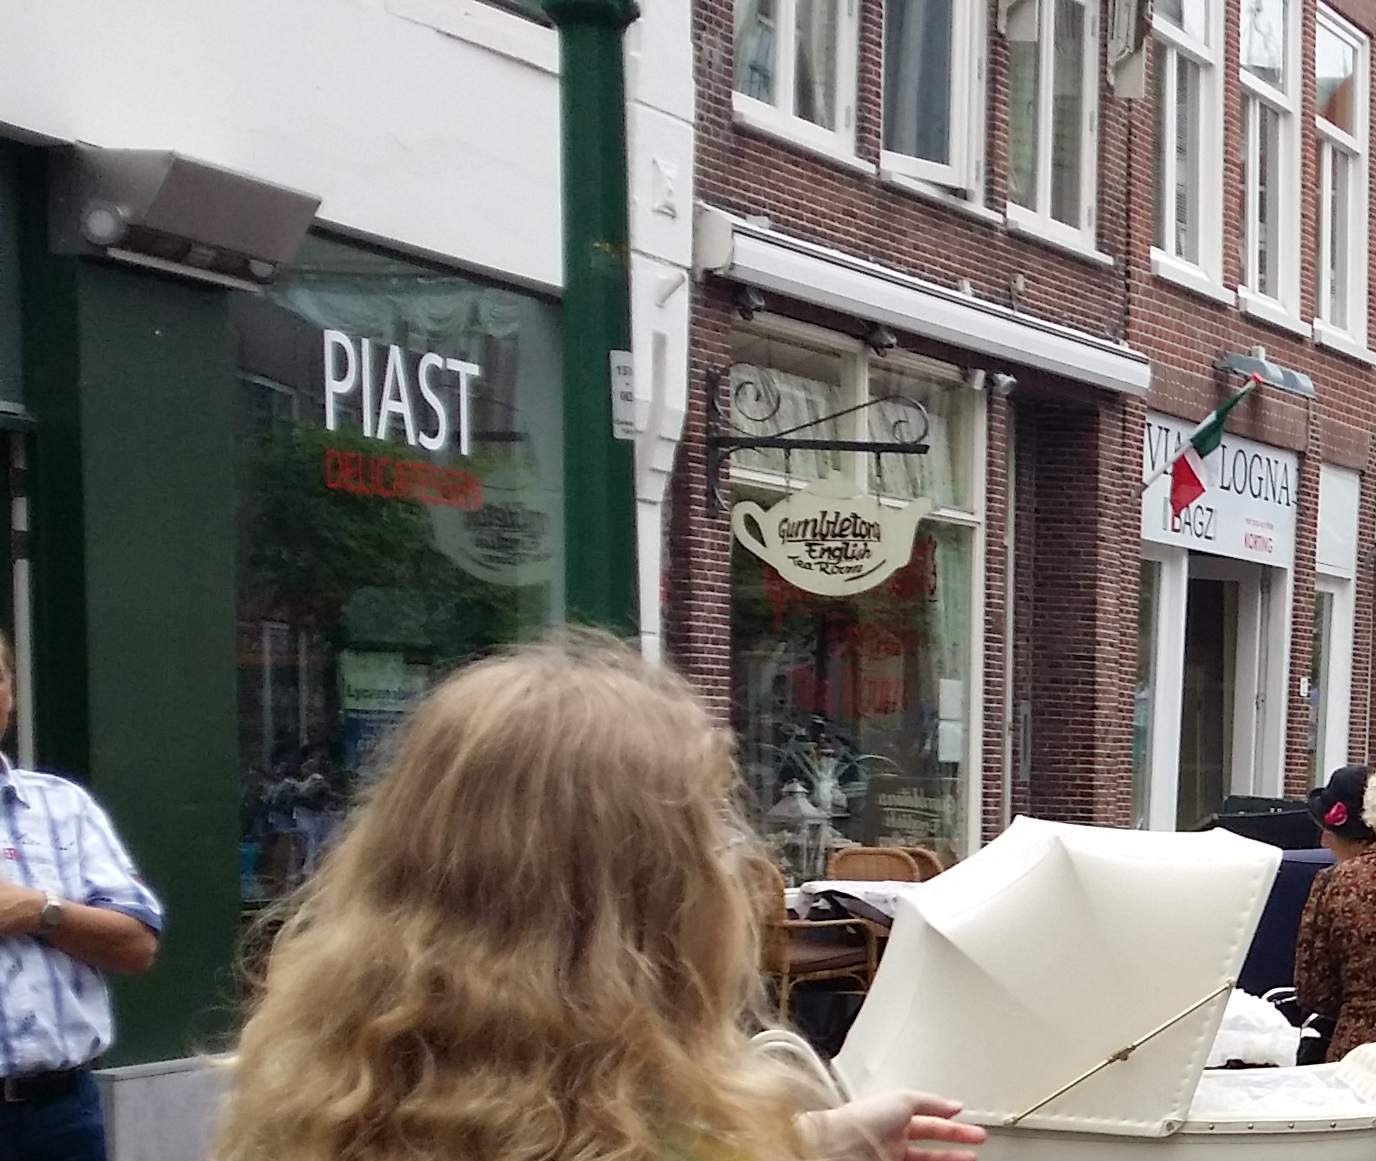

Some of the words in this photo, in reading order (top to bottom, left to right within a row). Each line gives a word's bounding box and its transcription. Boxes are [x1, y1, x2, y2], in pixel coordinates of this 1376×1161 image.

[324, 329, 481, 456] PIAST
[1219, 444, 1291, 507] LOGNA
[787, 555, 814, 571] Tea
[805, 542, 871, 564] English
